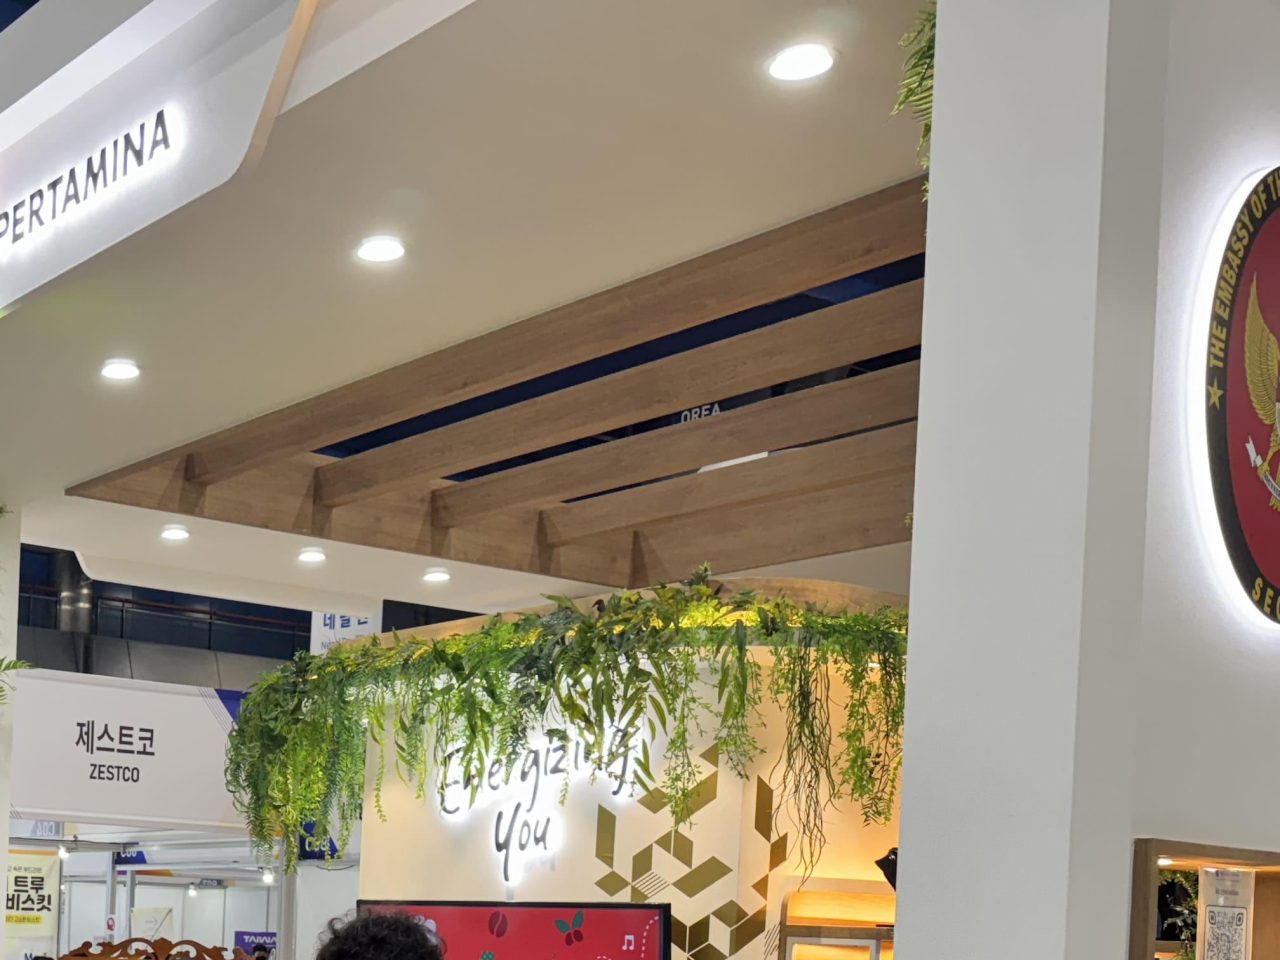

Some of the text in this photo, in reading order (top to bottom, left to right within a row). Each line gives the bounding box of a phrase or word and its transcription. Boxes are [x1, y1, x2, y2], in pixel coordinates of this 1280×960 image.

[1251, 183, 1269, 220] OF
[1215, 207, 1255, 320] EMBASSY
[1208, 322, 1227, 368] THE
[75, 720, 156, 757] 제스트코
[89, 763, 140, 783] ZESTCO
[494, 802, 551, 882] You
[6, 894, 52, 912] 비스킷
[14, 876, 45, 894] 트루
